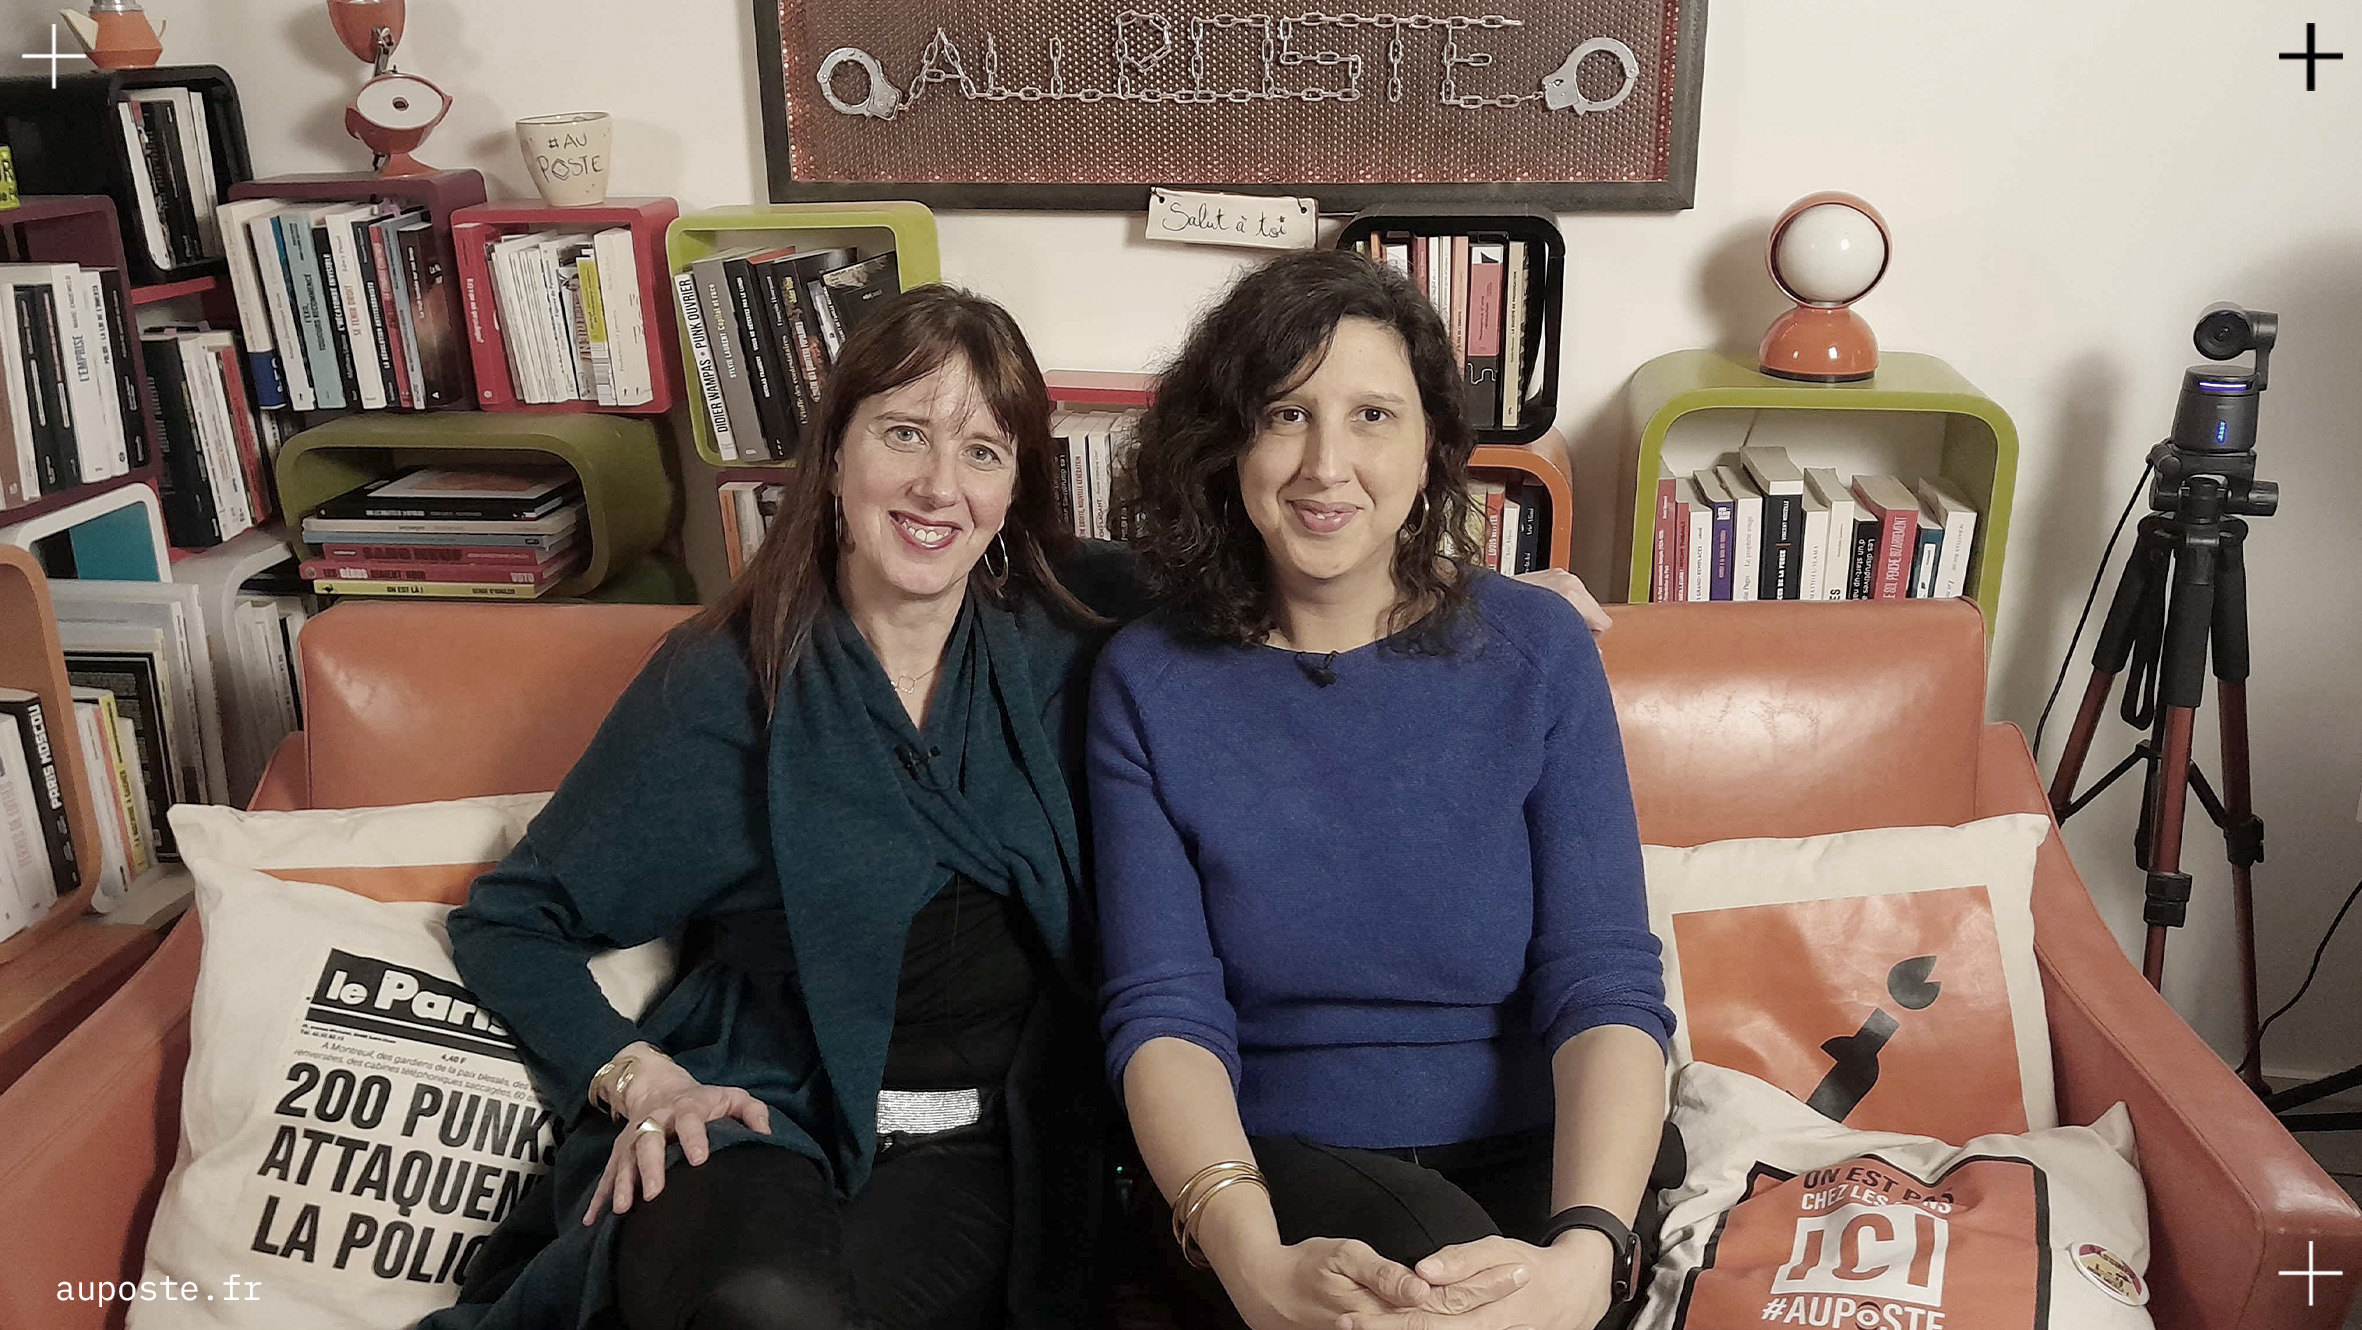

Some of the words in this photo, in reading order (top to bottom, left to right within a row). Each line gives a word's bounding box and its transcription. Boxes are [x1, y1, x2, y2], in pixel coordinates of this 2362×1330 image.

[548, 133, 587, 149] #AU
[1162, 202, 1229, 231] Salut
[1235, 215, 1247, 233] à
[1255, 211, 1287, 238] toi
[322, 252, 336, 286] INVISIBLE
[343, 284, 355, 305] DROIT
[678, 278, 699, 320] OUVRIER
[689, 321, 707, 349] PUNK
[712, 307, 727, 331] Capital
[71, 334, 90, 381] L'EMPRISE
[719, 331, 732, 358] LAURENT
[699, 358, 720, 401] WAMPAS
[725, 357, 737, 378] SYLVIE
[710, 401, 729, 433] DIDIER
[1856, 538, 1865, 555] d'un
[1865, 538, 1875, 551] Les
[1888, 514, 1907, 556] BIZARREMENT
[1853, 556, 1864, 586] start-up
[1861, 551, 1874, 594] disruptives
[27, 703, 52, 762] MOSCOU
[41, 763, 63, 809] PARIS
[326, 970, 368, 1005] le
[345, 1055, 363, 1067] des
[363, 1058, 400, 1073] cabines
[400, 1065, 464, 1088] téléphoniques
[375, 1051, 393, 1062] des
[392, 1055, 433, 1071] gardiens
[433, 1062, 446, 1073] de
[447, 1065, 457, 1075] la
[456, 1067, 476, 1080] paix
[274, 1062, 392, 1130] 200
[257, 1125, 542, 1222] ATTAQUEN
[1803, 1168, 1841, 1189] ON
[1845, 1167, 1899, 1193] EST
[1801, 1184, 1849, 1211] CHEZ
[1850, 1186, 1889, 1207] LES
[251, 1196, 321, 1263] LA
[1761, 1296, 1946, 1330] #AUPOSTE
